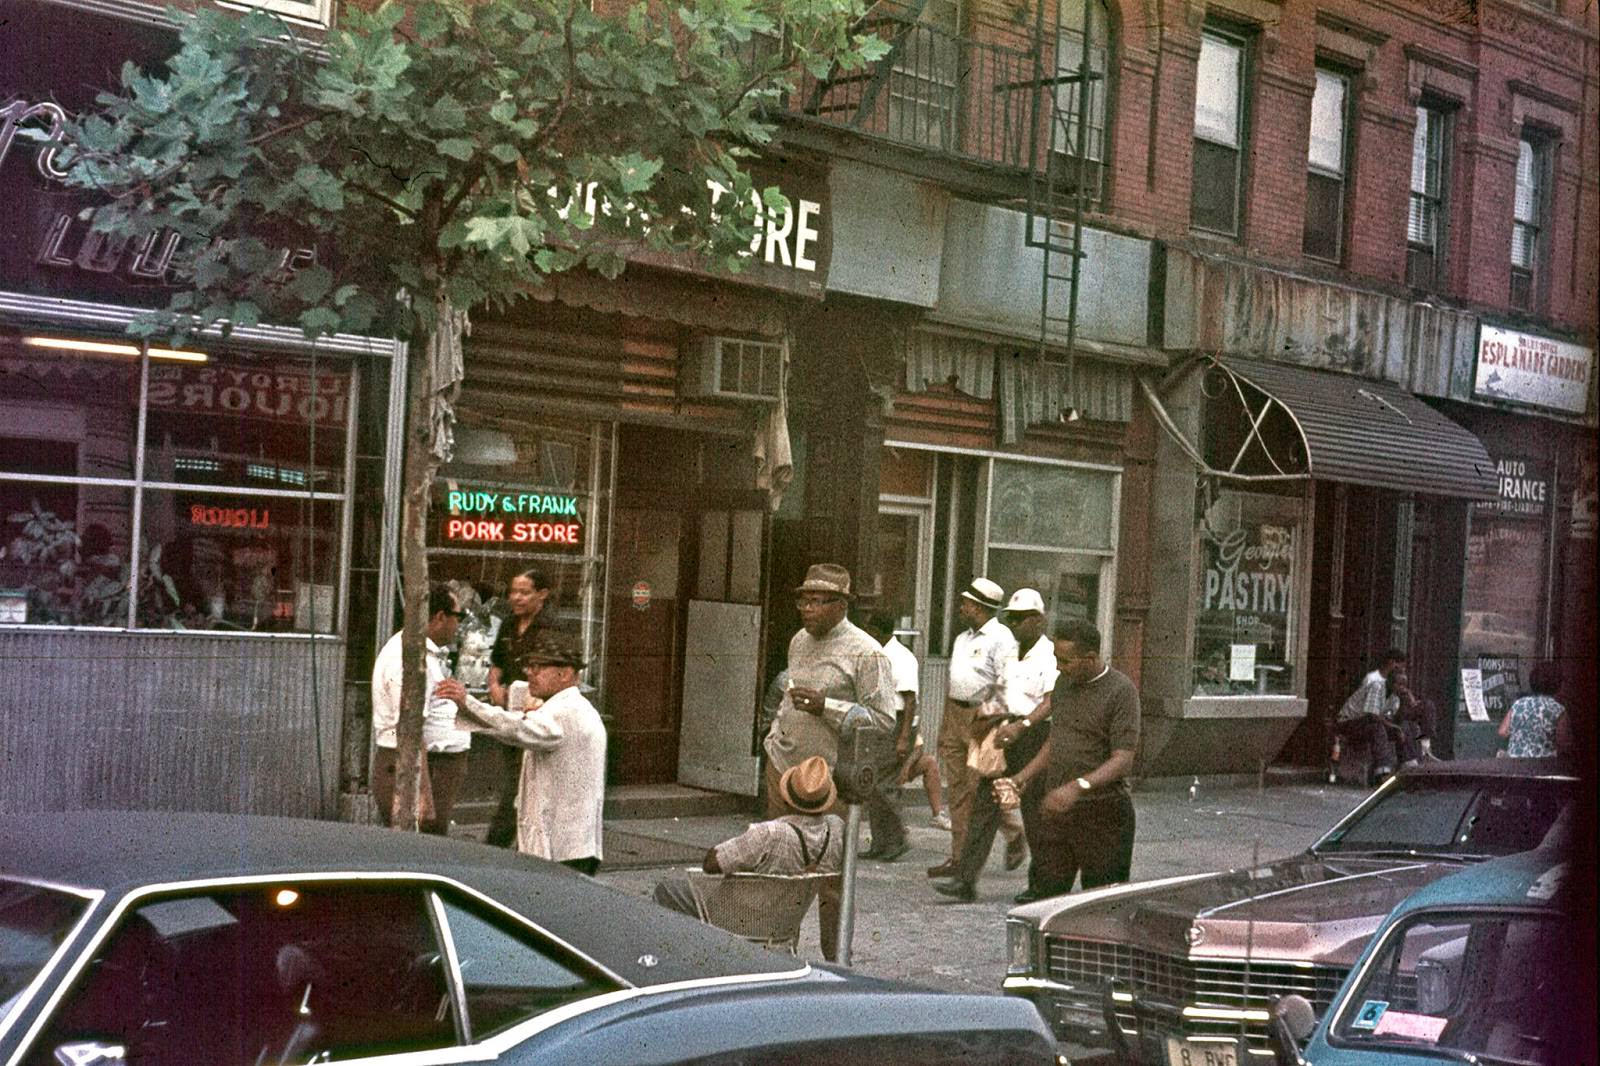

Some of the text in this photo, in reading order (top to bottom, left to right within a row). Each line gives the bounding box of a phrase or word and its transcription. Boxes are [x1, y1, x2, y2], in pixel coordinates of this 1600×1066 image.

[1481, 340, 1545, 374] ESPLANADE
[1496, 460, 1526, 476] AUTO
[448, 491, 577, 515] RUDY & FRANK
[449, 520, 579, 543] PORK STORE
[1204, 568, 1292, 613] PASTRY
